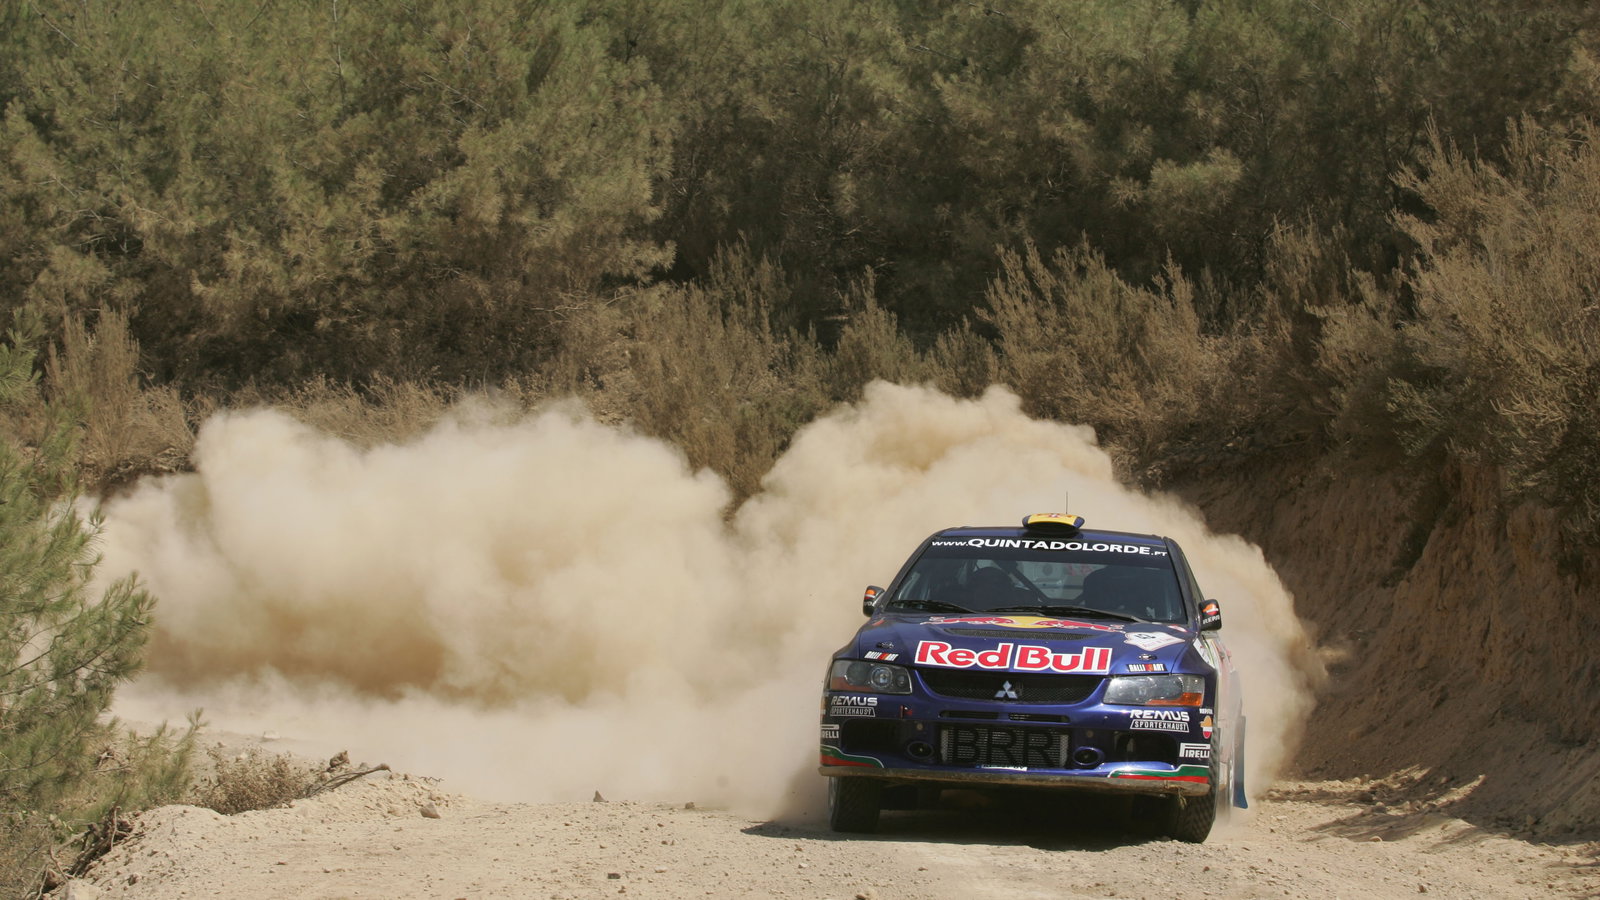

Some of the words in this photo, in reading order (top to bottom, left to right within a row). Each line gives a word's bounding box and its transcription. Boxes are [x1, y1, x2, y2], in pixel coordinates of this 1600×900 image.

[915, 640, 1013, 668] Red
[1014, 645, 1112, 673] Bull
[831, 696, 878, 706] REMUS
[1130, 709, 1190, 721] REMUS
[1134, 721, 1186, 730] SPORTEXHAUST
[951, 728, 1057, 767] BRR
